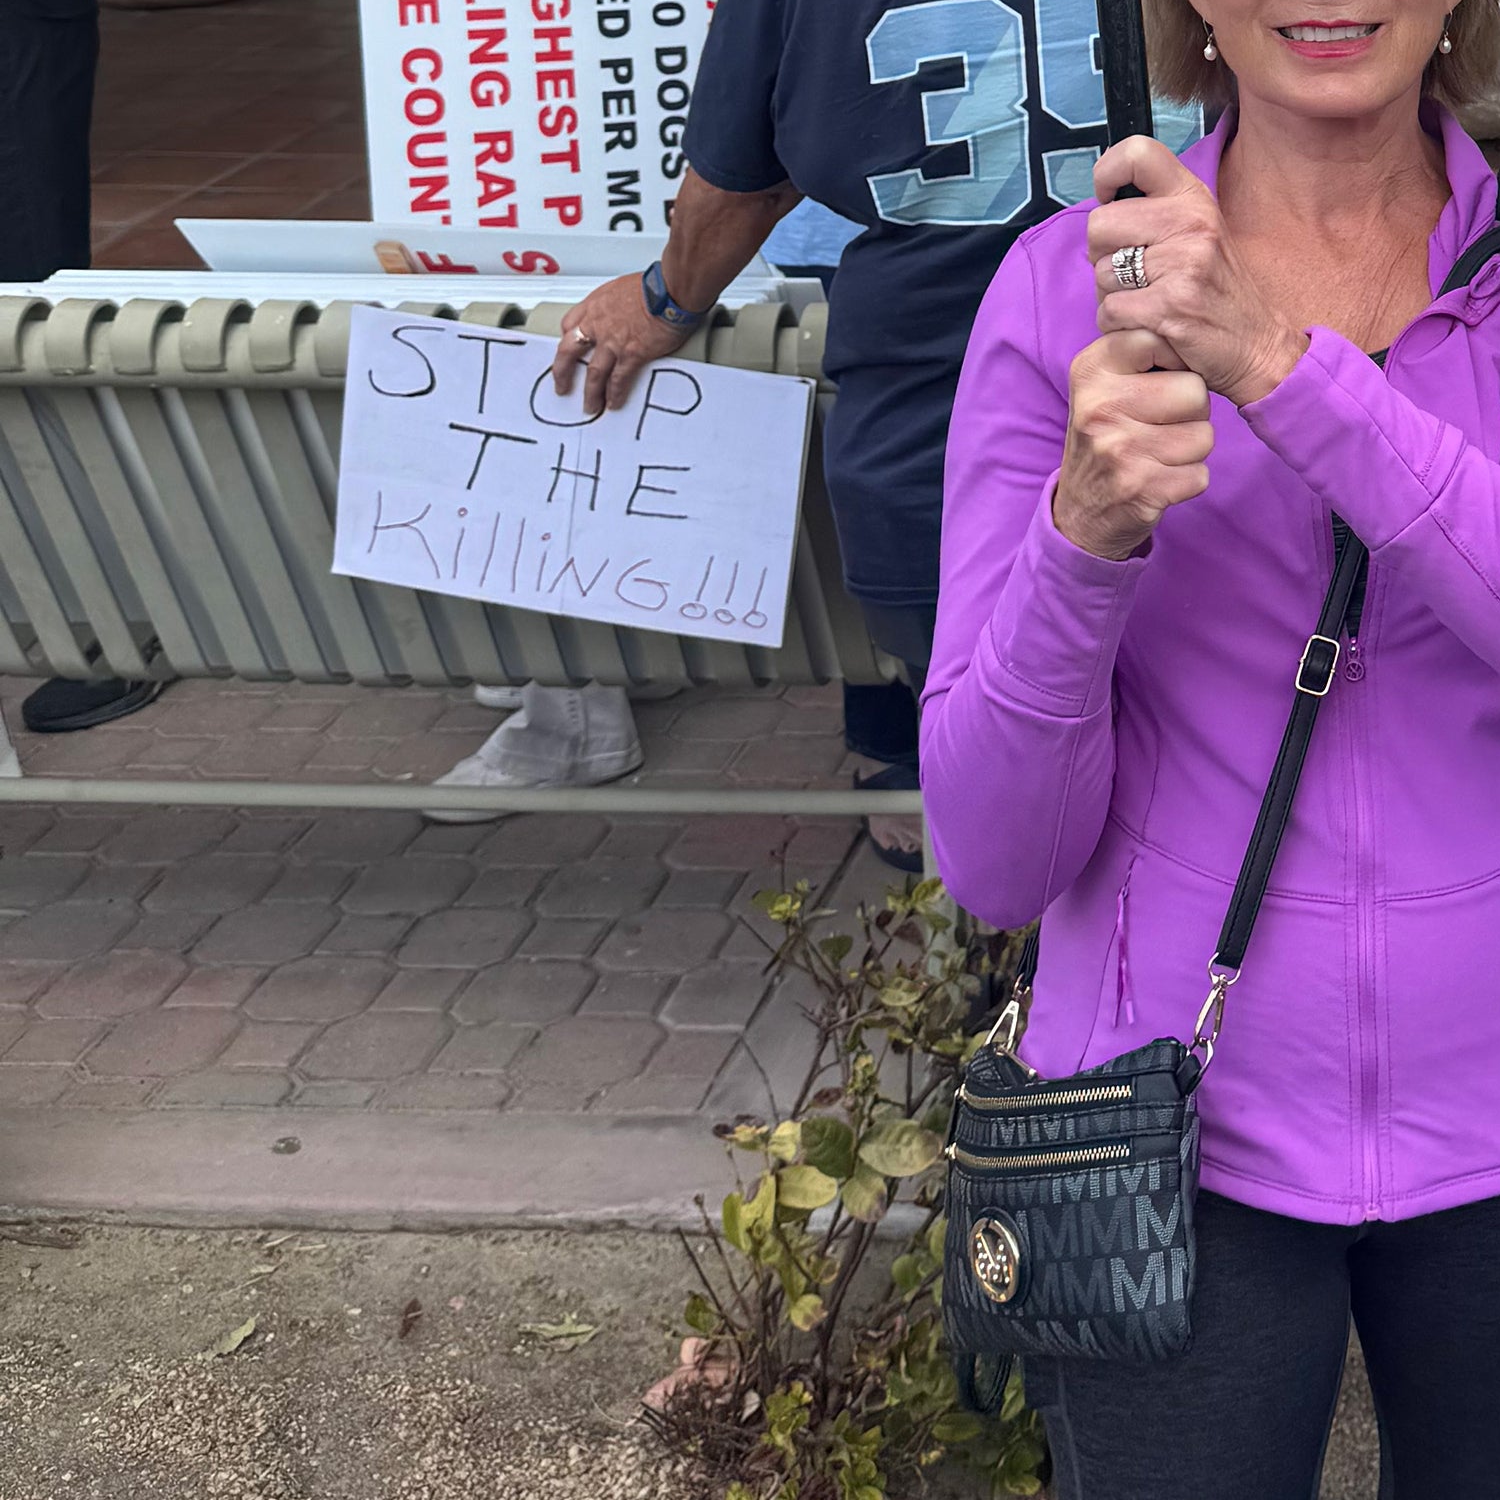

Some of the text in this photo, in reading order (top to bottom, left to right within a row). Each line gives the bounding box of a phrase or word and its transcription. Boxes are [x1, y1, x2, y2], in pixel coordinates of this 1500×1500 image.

[401, 47, 452, 226] COUN
[600, 57, 639, 153] PER
[654, 45, 691, 181] DOGS
[368, 324, 703, 441] STOP
[448, 421, 692, 520] THE
